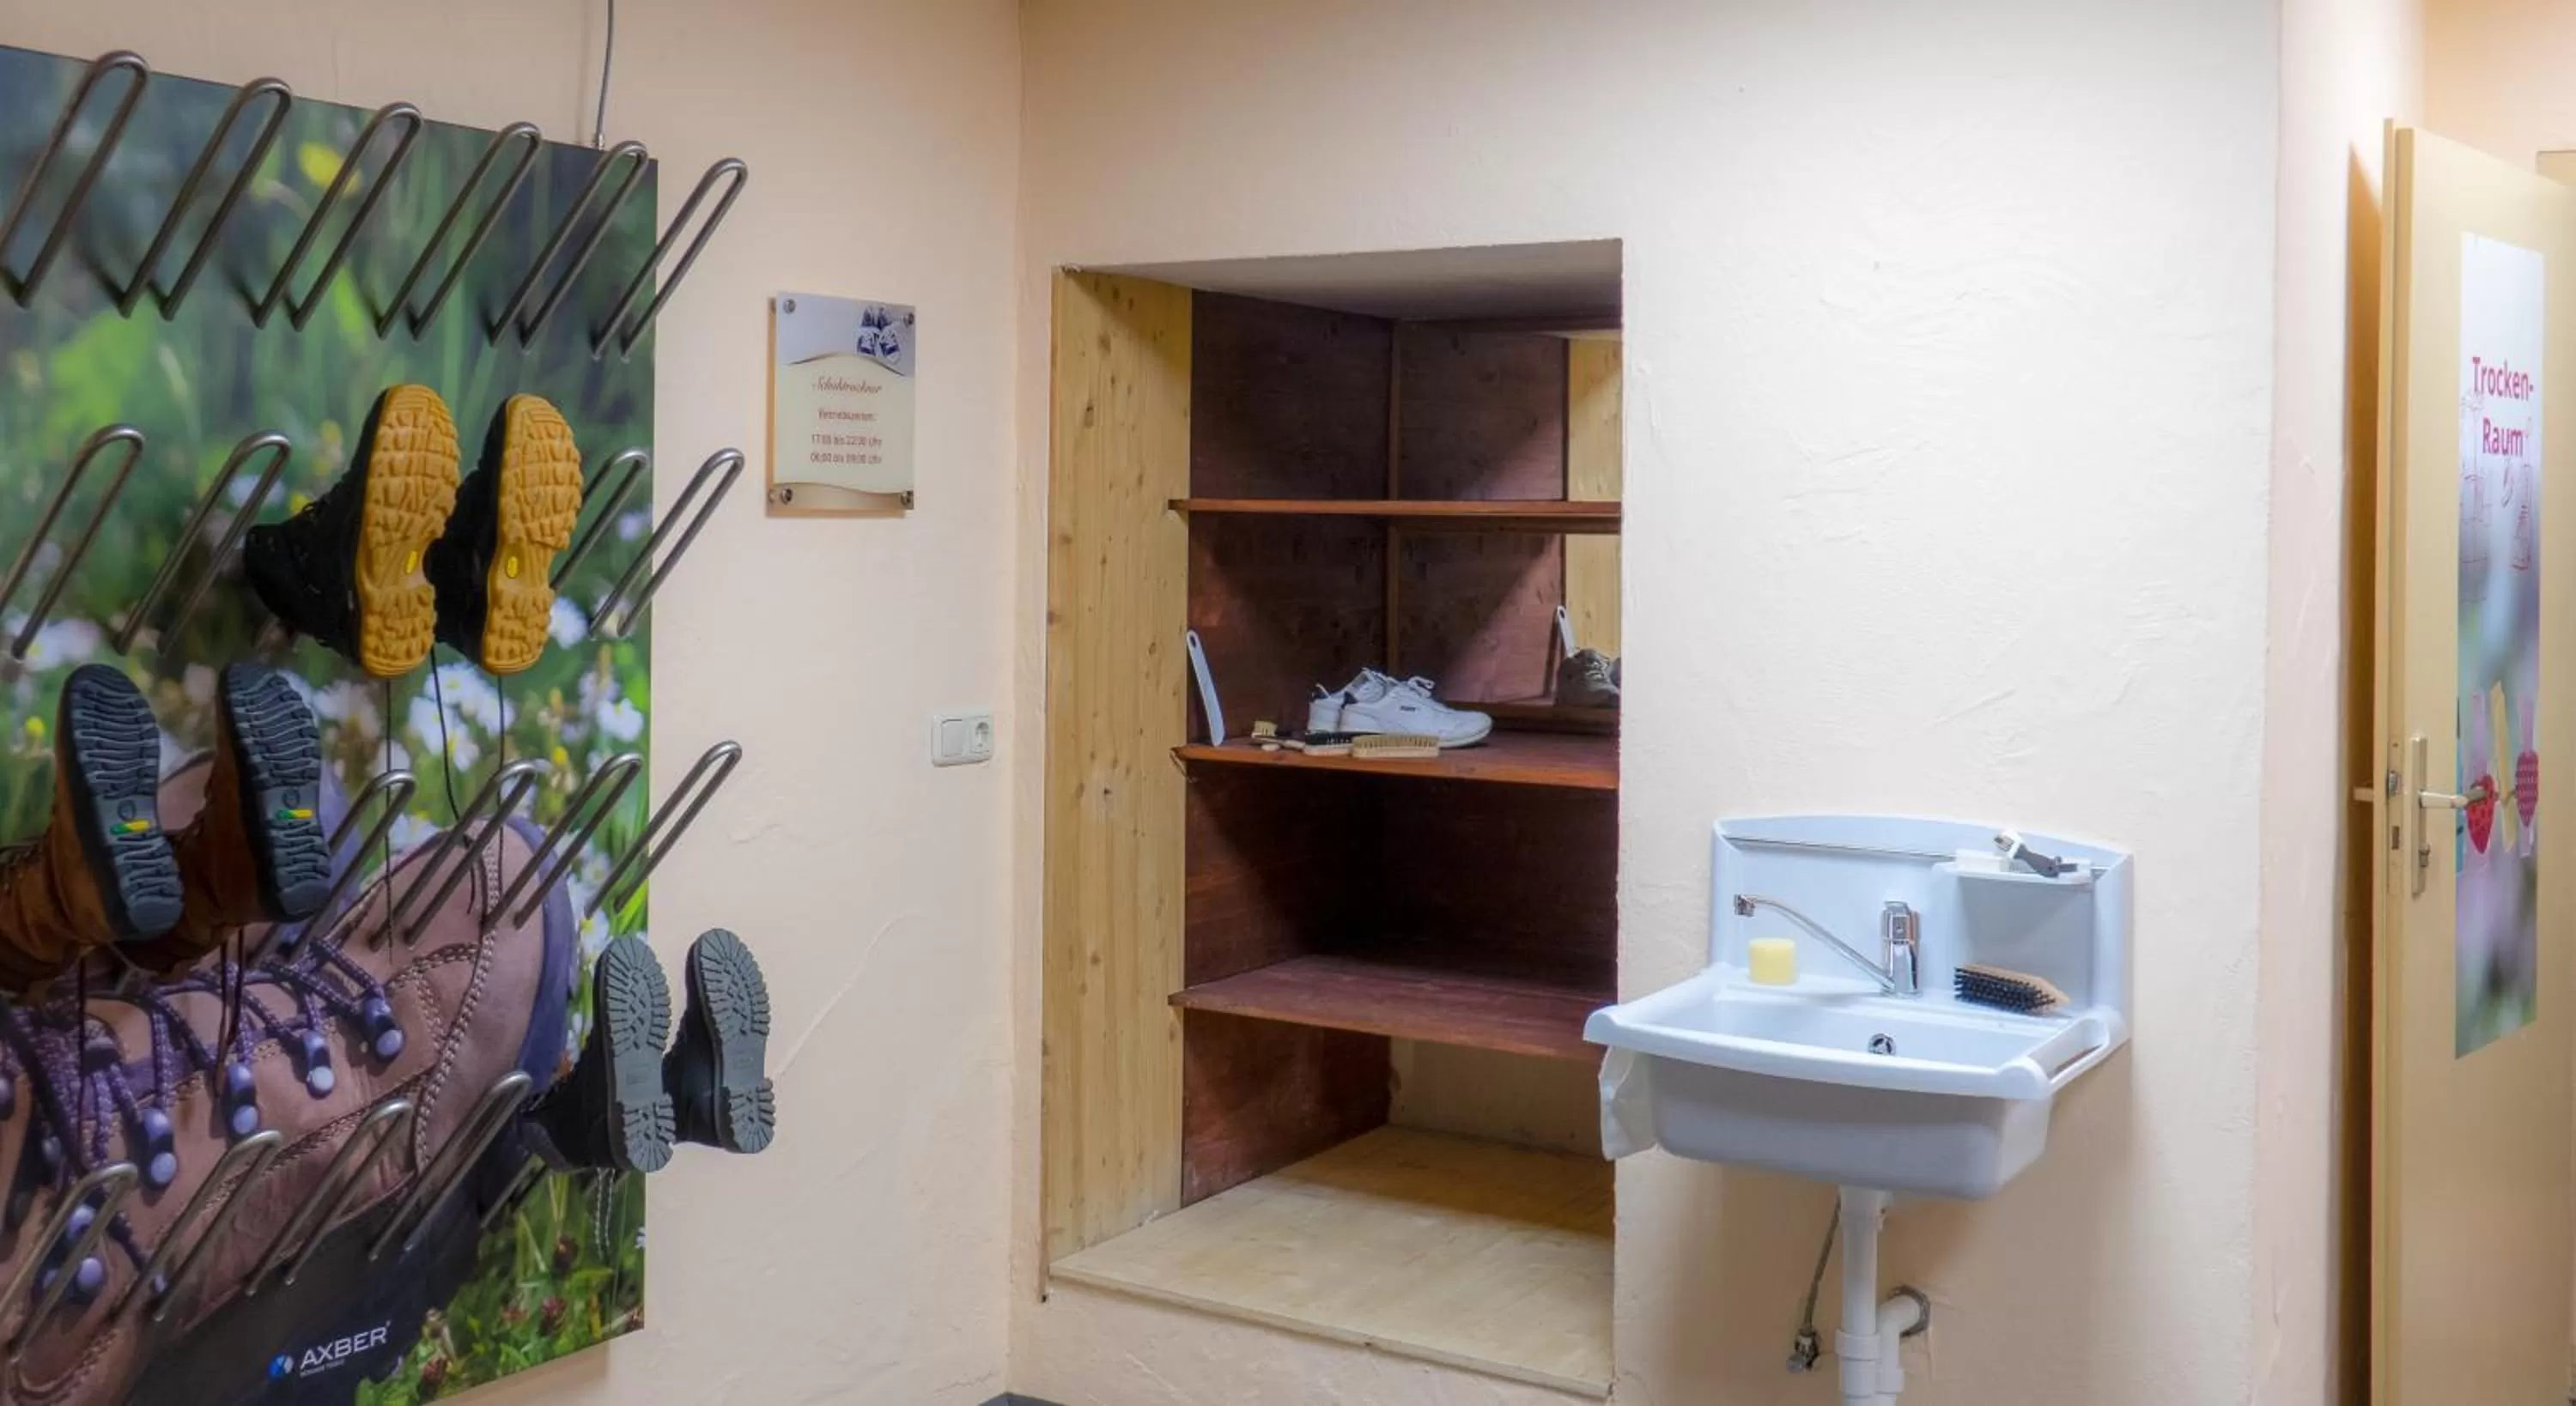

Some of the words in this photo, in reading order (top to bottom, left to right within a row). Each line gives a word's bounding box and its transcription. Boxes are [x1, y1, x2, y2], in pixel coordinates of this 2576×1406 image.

[2472, 356, 2534, 402] Trocken-
[2482, 417, 2524, 457] Raum
[300, 1326, 387, 1370] AXBER
